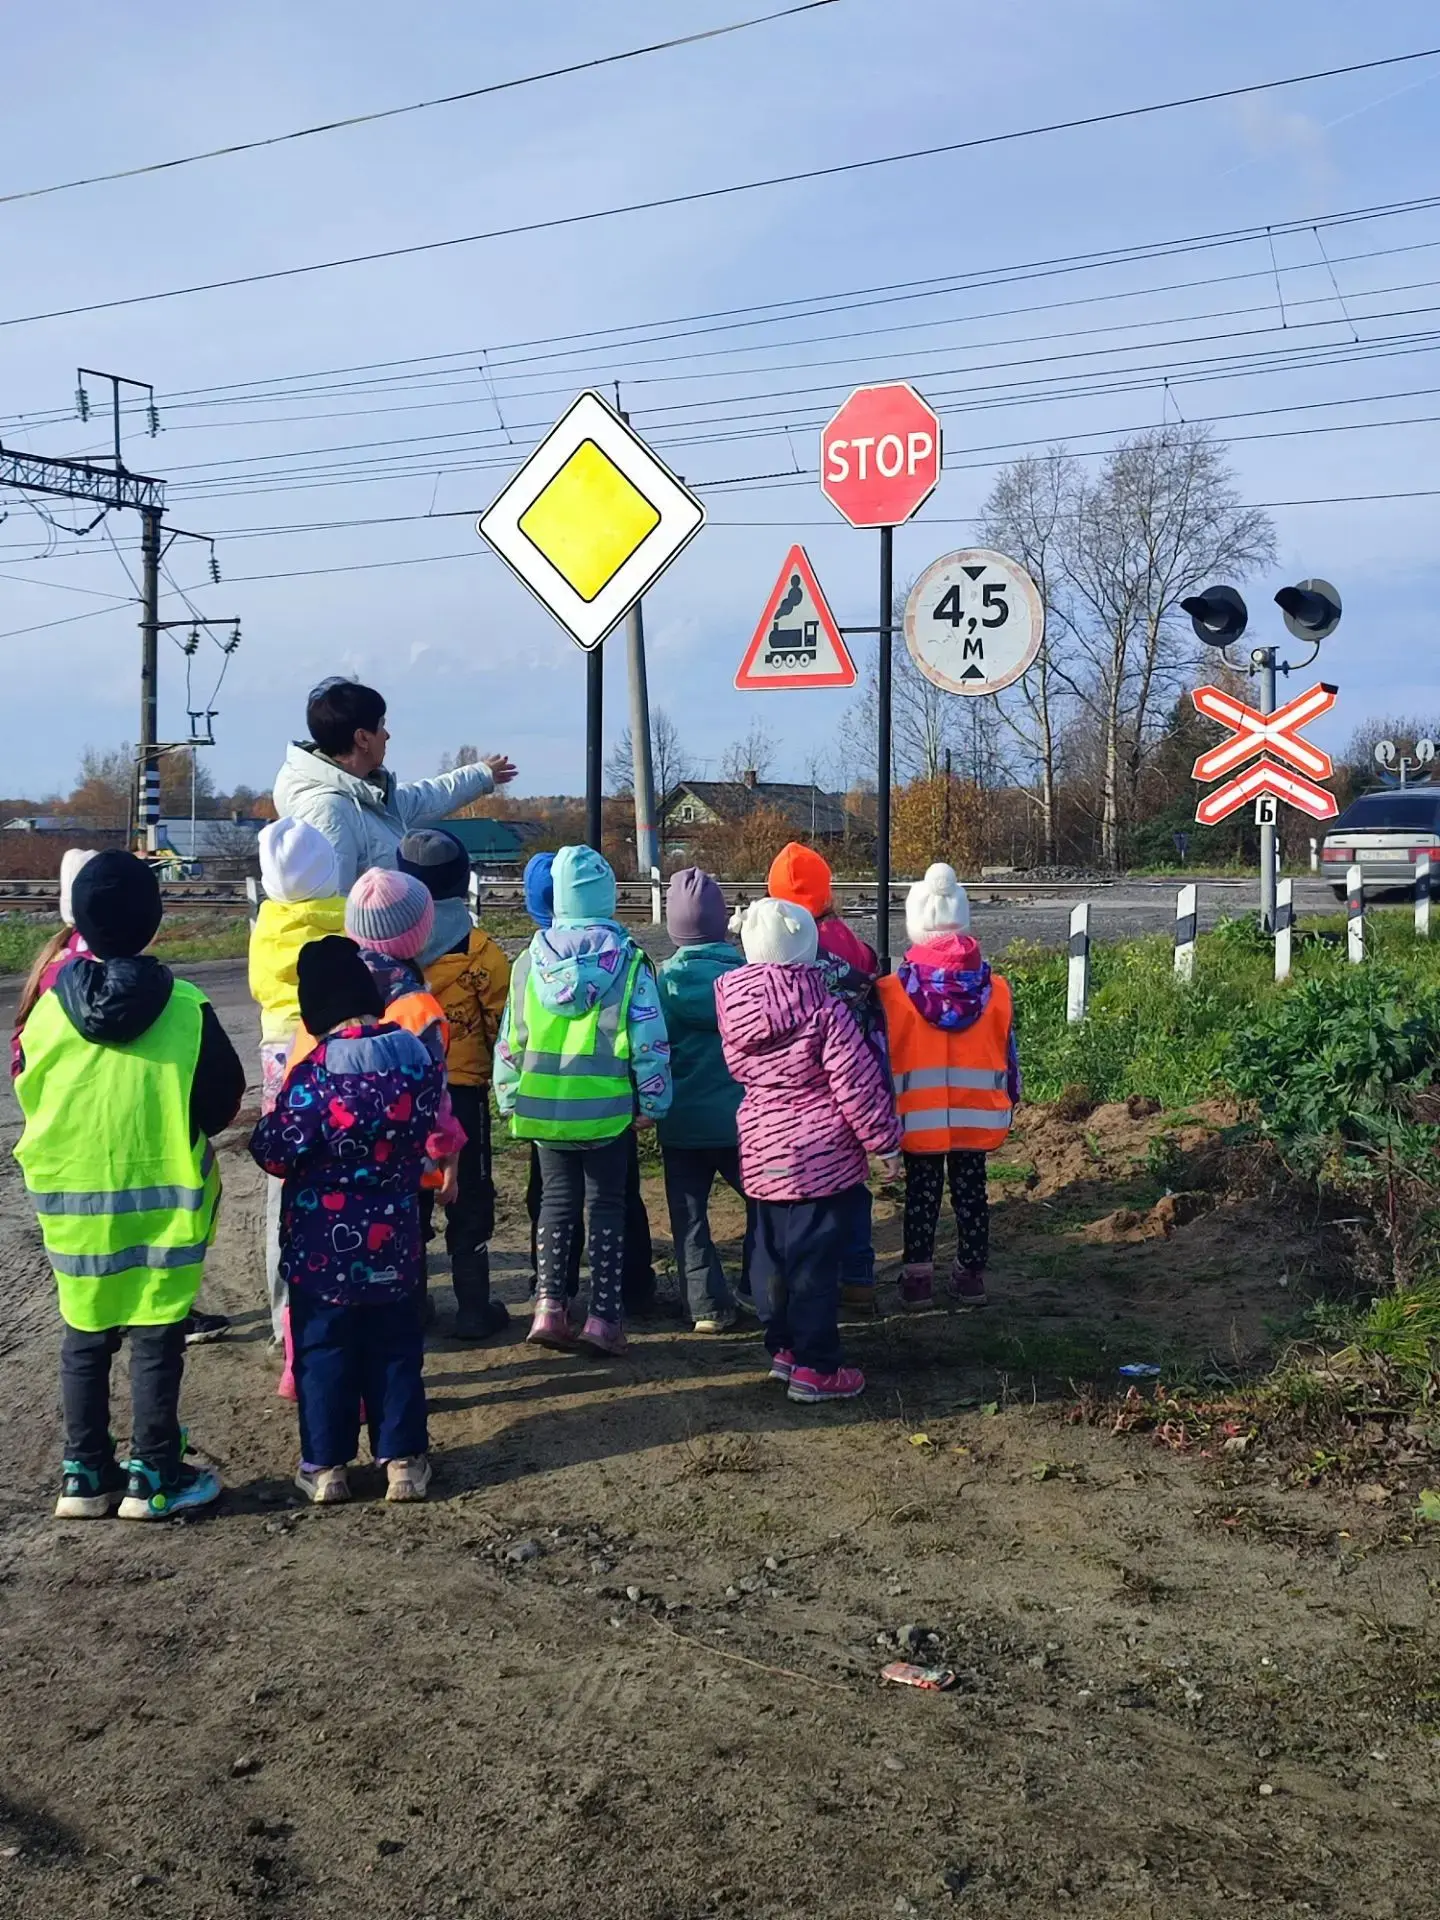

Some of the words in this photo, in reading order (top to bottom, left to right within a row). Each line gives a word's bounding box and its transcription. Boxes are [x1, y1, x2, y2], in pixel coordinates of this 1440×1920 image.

[827, 431, 934, 483] STOP
[933, 584, 1009, 635] 4,5
[1260, 800, 1273, 823] Б
